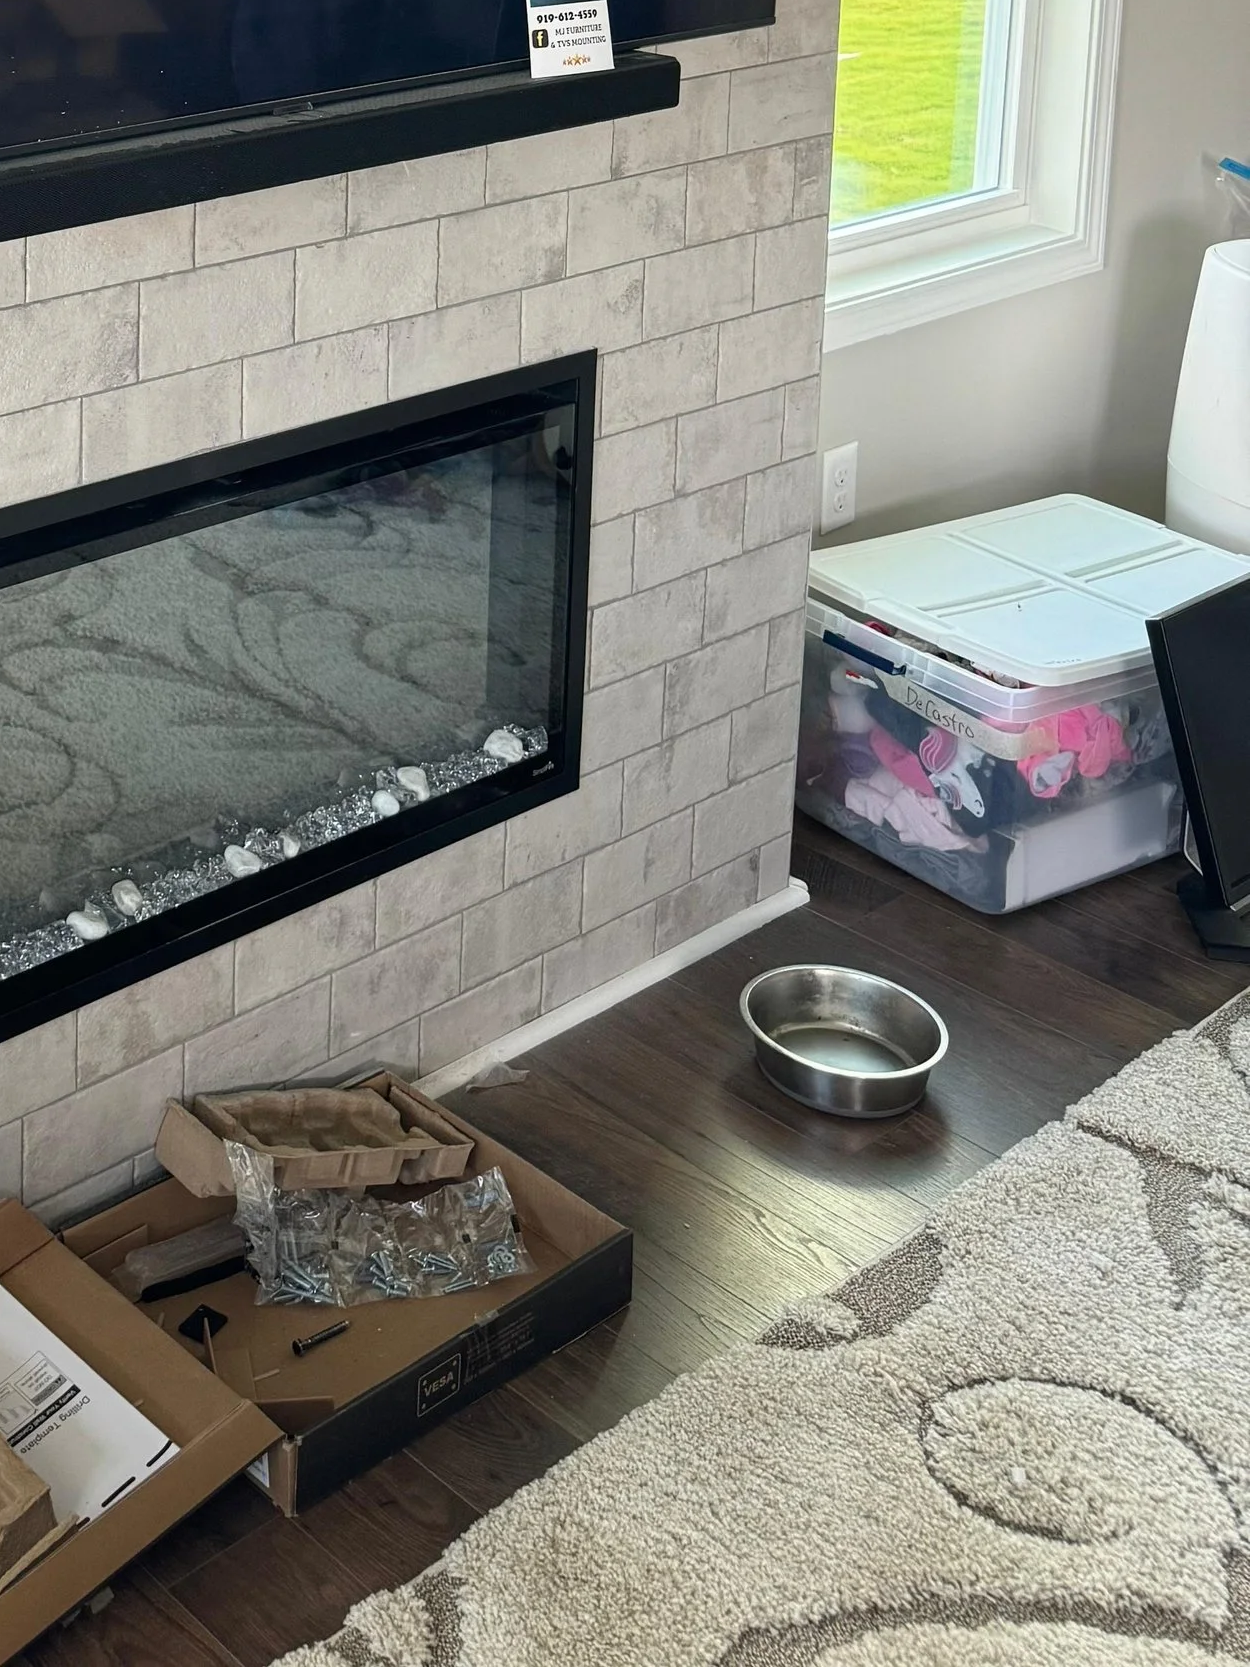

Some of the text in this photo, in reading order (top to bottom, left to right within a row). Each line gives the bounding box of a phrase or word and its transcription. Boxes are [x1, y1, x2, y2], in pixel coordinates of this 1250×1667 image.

[537, 9, 598, 24] 919-612-4559
[555, 24, 602, 36] MJ FURNITURE
[572, 36, 607, 47] MOUNTING
[424, 1371, 455, 1397] VESA
[20, 1395, 91, 1454] Drilling Template
